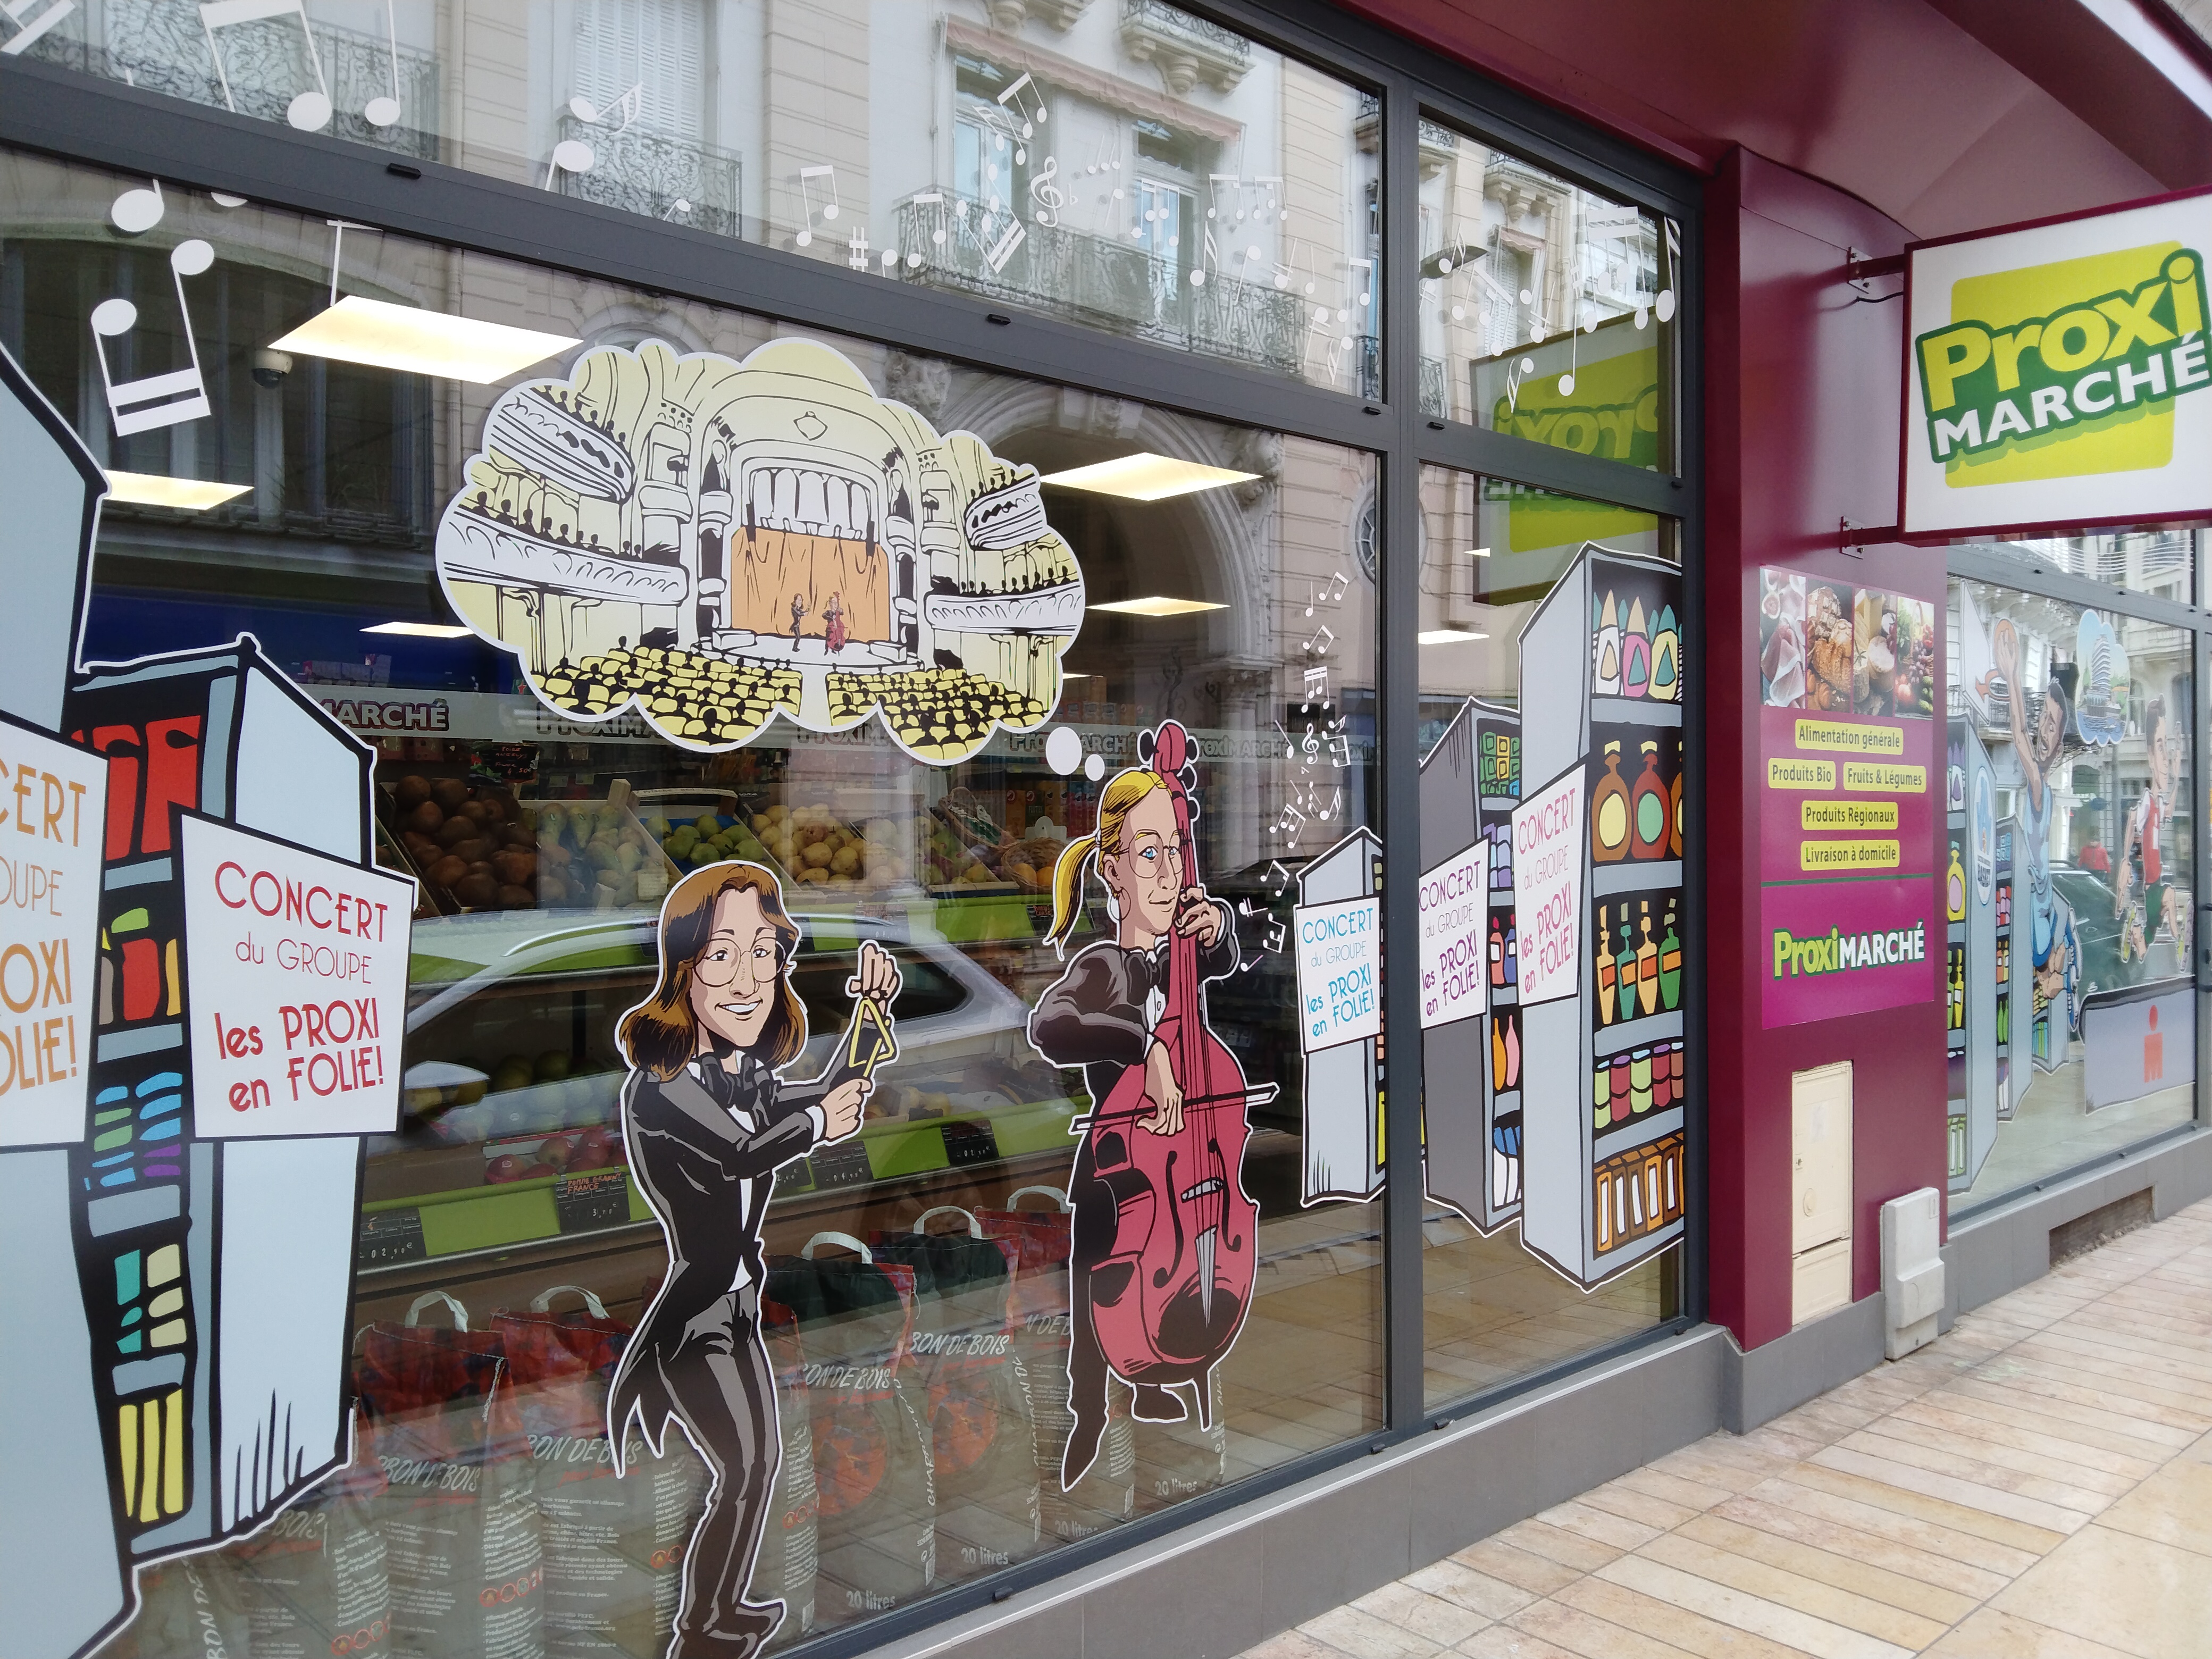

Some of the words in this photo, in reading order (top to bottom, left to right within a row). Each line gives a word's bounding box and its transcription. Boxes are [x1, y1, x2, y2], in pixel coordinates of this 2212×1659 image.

[1922, 255, 2203, 413] Proxi
[1934, 332, 2210, 456] MARCHÉ
[1798, 725, 1859, 745] Alimentation
[1862, 730, 1900, 749] générale
[1772, 764, 1814, 782] Produits
[1816, 766, 1832, 782] Bio
[1847, 767, 1873, 784] Fruits
[1875, 769, 1882, 784] &
[1884, 770, 1922, 789] Légumes
[1518, 787, 1576, 854] CONCERT
[1806, 806, 1846, 823] Produits
[1848, 806, 1895, 826] Régionaux
[1524, 866, 1532, 890] du
[1535, 844, 1569, 885] GROUPE
[1805, 847, 1849, 863] Livraison
[1851, 845, 1856, 861] à
[1858, 844, 1896, 861] domicile
[214, 861, 388, 942] CONCERT
[1419, 860, 1480, 912] CONCERT
[1302, 907, 1373, 944] CONCERT
[1425, 919, 1435, 938] du
[1437, 902, 1474, 934] GROUPE
[1520, 930, 1534, 961] les
[1536, 880, 1572, 945] PROXI
[235, 931, 264, 965] du
[276, 939, 371, 984] GROUPE
[1311, 951, 1322, 967] du
[1326, 940, 1367, 964] GROUPE
[1421, 968, 1436, 992] les
[1439, 928, 1478, 979] PROXI
[1524, 969, 1536, 994] en
[1539, 923, 1574, 981] FOLIE!
[1305, 994, 1324, 1015] les
[1328, 962, 1372, 1003] PROXI
[1426, 998, 1439, 1017] en
[1443, 960, 1480, 1006] FOLIE!
[214, 1012, 264, 1060] les
[278, 997, 380, 1051] PROXI
[1312, 1019, 1328, 1037] en
[1332, 988, 1375, 1027] FOLIE!
[229, 1078, 271, 1112] en
[286, 1045, 384, 1101] FOLIE!
[567, 1183, 600, 1194] FRANCE
[966, 1334, 1010, 1356] BOIS
[829, 1366, 860, 1388] DE
[853, 1367, 891, 1390] BOIS
[566, 1437, 603, 1463] DE
[438, 1463, 481, 1493] BOIS
[1154, 1480, 1170, 1496] 20
[1171, 1477, 1197, 1493] litres
[1054, 1520, 1069, 1537] 20
[961, 1547, 977, 1564] 20
[979, 1546, 1009, 1565] litres
[845, 1590, 862, 1609] 20
[865, 1589, 896, 1610] litres
